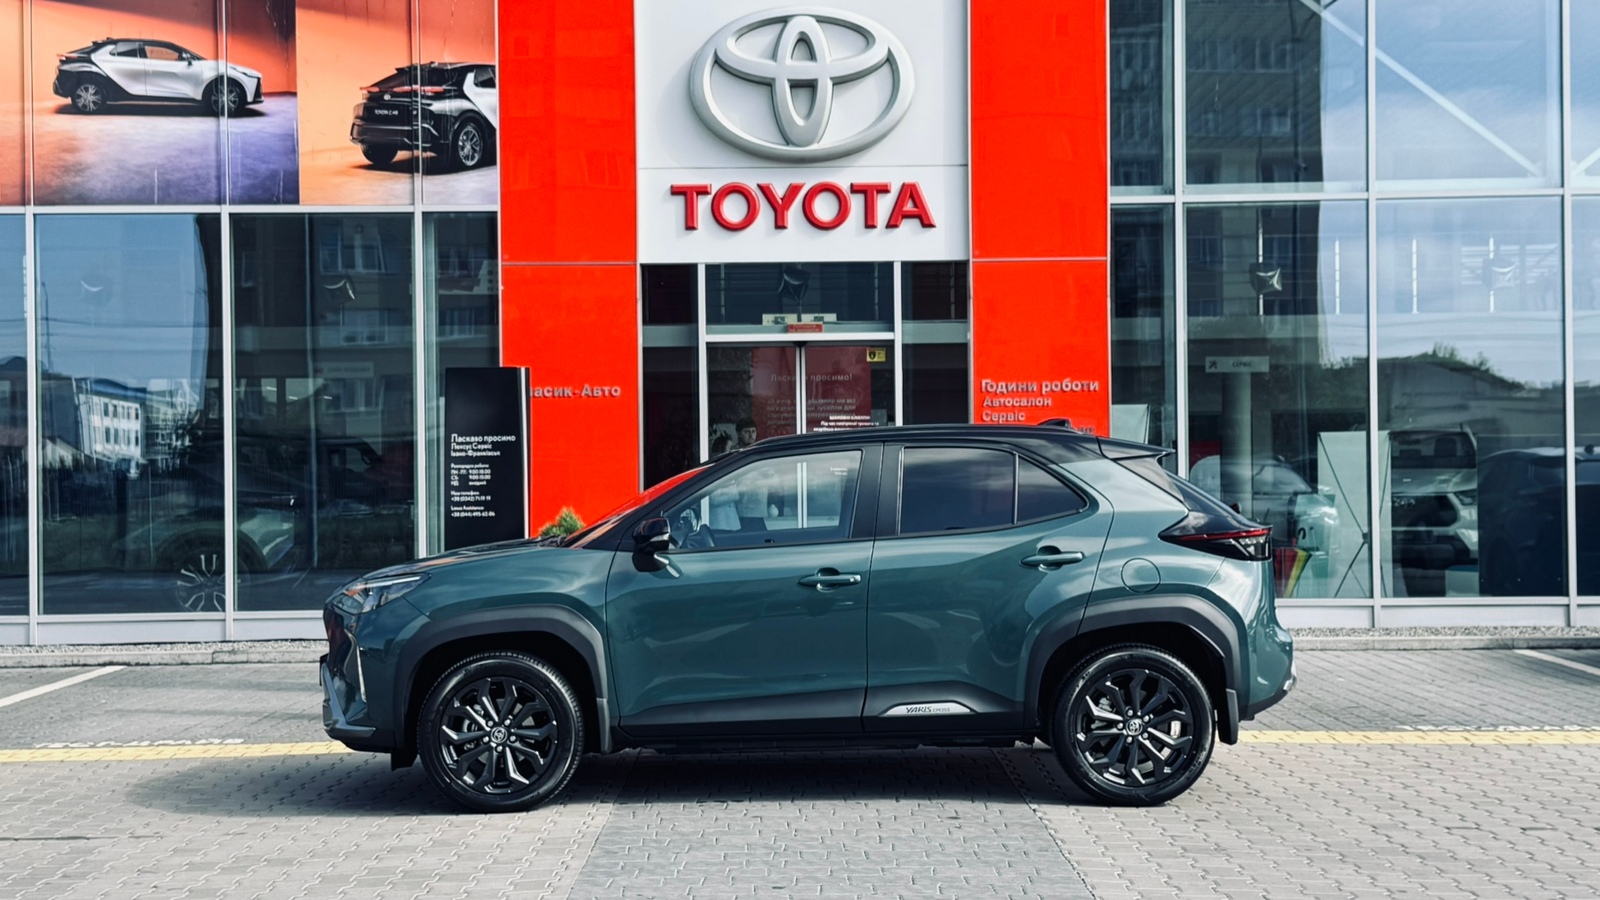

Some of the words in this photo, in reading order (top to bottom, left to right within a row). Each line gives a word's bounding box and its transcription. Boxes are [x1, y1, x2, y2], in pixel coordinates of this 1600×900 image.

[670, 181, 936, 231] TOYOTA
[530, 384, 621, 398] асик-Авто
[981, 380, 1037, 394] Години
[1042, 378, 1099, 395] роботи
[983, 397, 1052, 407] Автосалон
[982, 411, 1026, 423] Сервіс
[451, 434, 483, 442] Ласкаво
[484, 435, 516, 443] просимо
